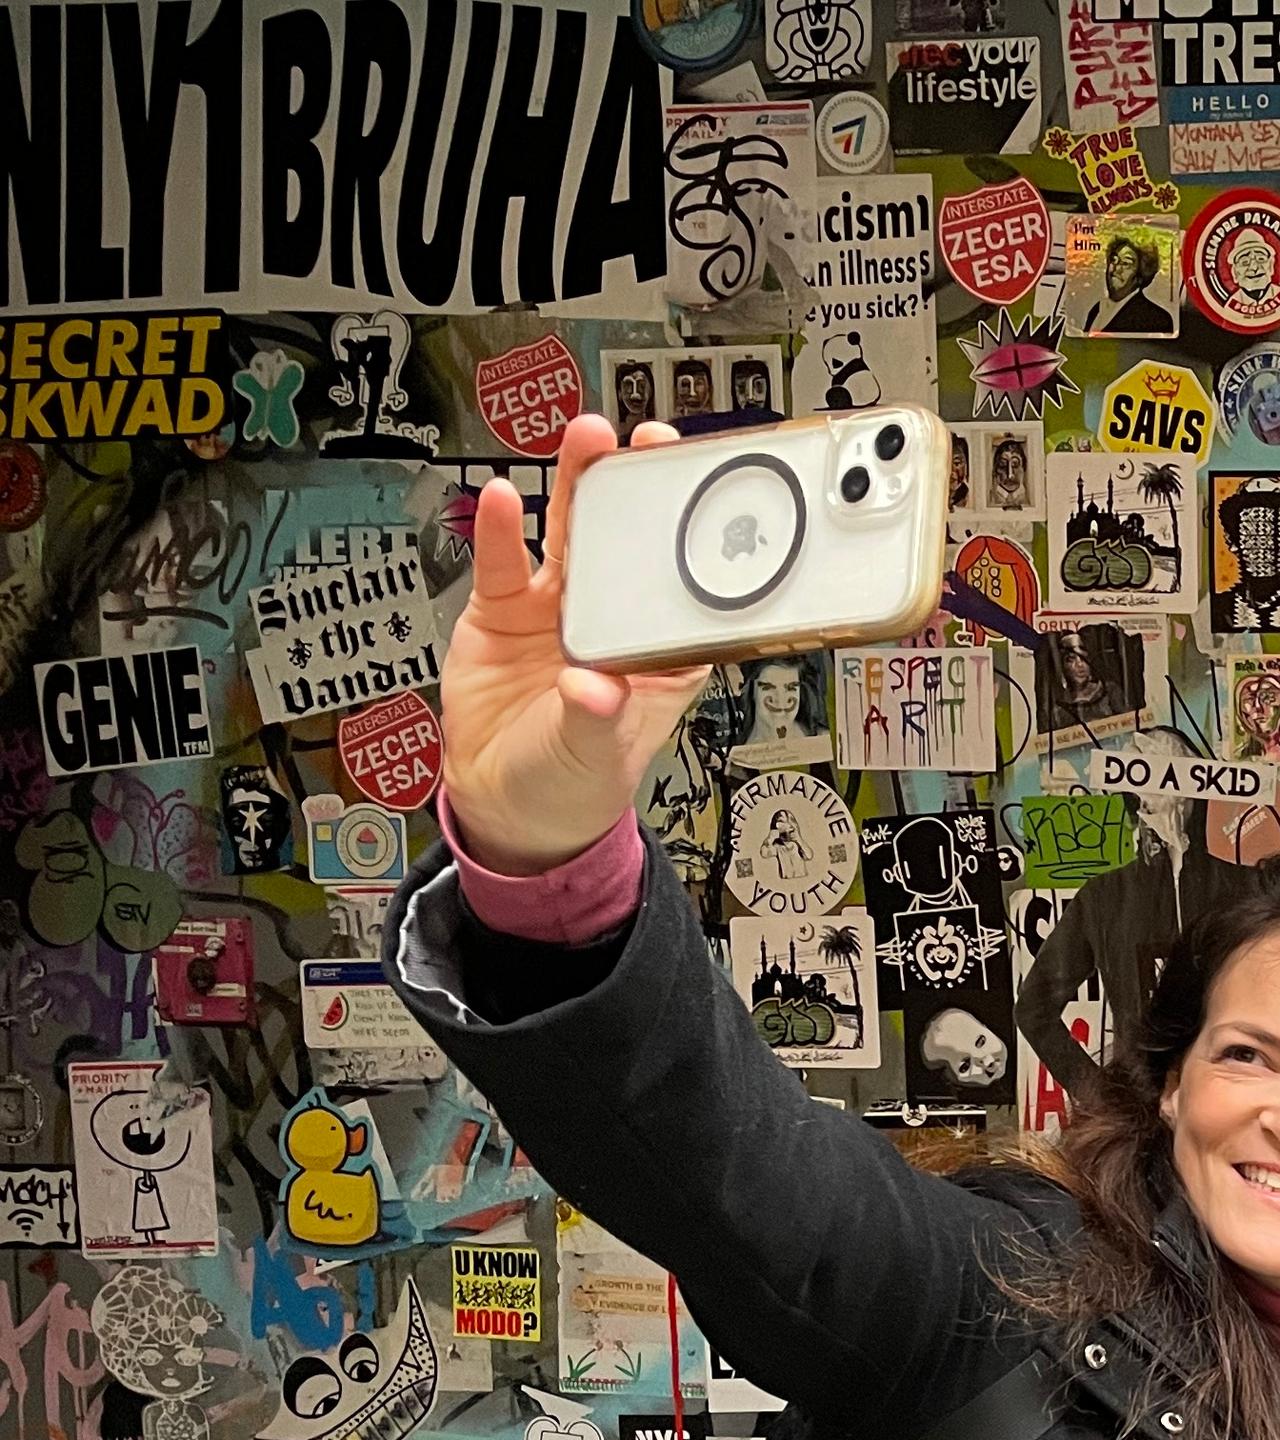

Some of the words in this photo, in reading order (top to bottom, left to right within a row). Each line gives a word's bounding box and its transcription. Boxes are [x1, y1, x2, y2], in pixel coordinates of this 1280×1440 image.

[906, 70, 1037, 106] lifestyle
[1192, 94, 1271, 112] HELLO
[262, 3, 668, 308] BRUHA
[1070, 127, 1134, 170] TRUE
[1079, 155, 1143, 196] LOVE
[945, 187, 1029, 220] INTERSTATE
[945, 211, 1045, 260] ZECER
[972, 253, 1034, 288] ESA
[480, 342, 558, 383] INTERSTATE
[486, 366, 578, 421] ZECER
[511, 414, 568, 447] ESA
[1110, 394, 1205, 452] SAVS
[258, 555, 420, 636] Sinclair
[320, 616, 376, 658] the
[43, 648, 206, 772] GENIE
[343, 698, 418, 736] INTERSTATE
[183, 739, 209, 756] TFM
[348, 722, 439, 775] ZECER
[379, 761, 433, 797] ESA
[1104, 758, 1152, 788] DO
[1159, 763, 1181, 789] A
[1190, 766, 1261, 798] SKID
[731, 775, 851, 854] AFFIRMATIVE
[750, 869, 845, 915] YOUTH
[455, 1250, 471, 1275] U
[472, 1251, 537, 1279] KNOW
[456, 1309, 537, 1339] MODO?
